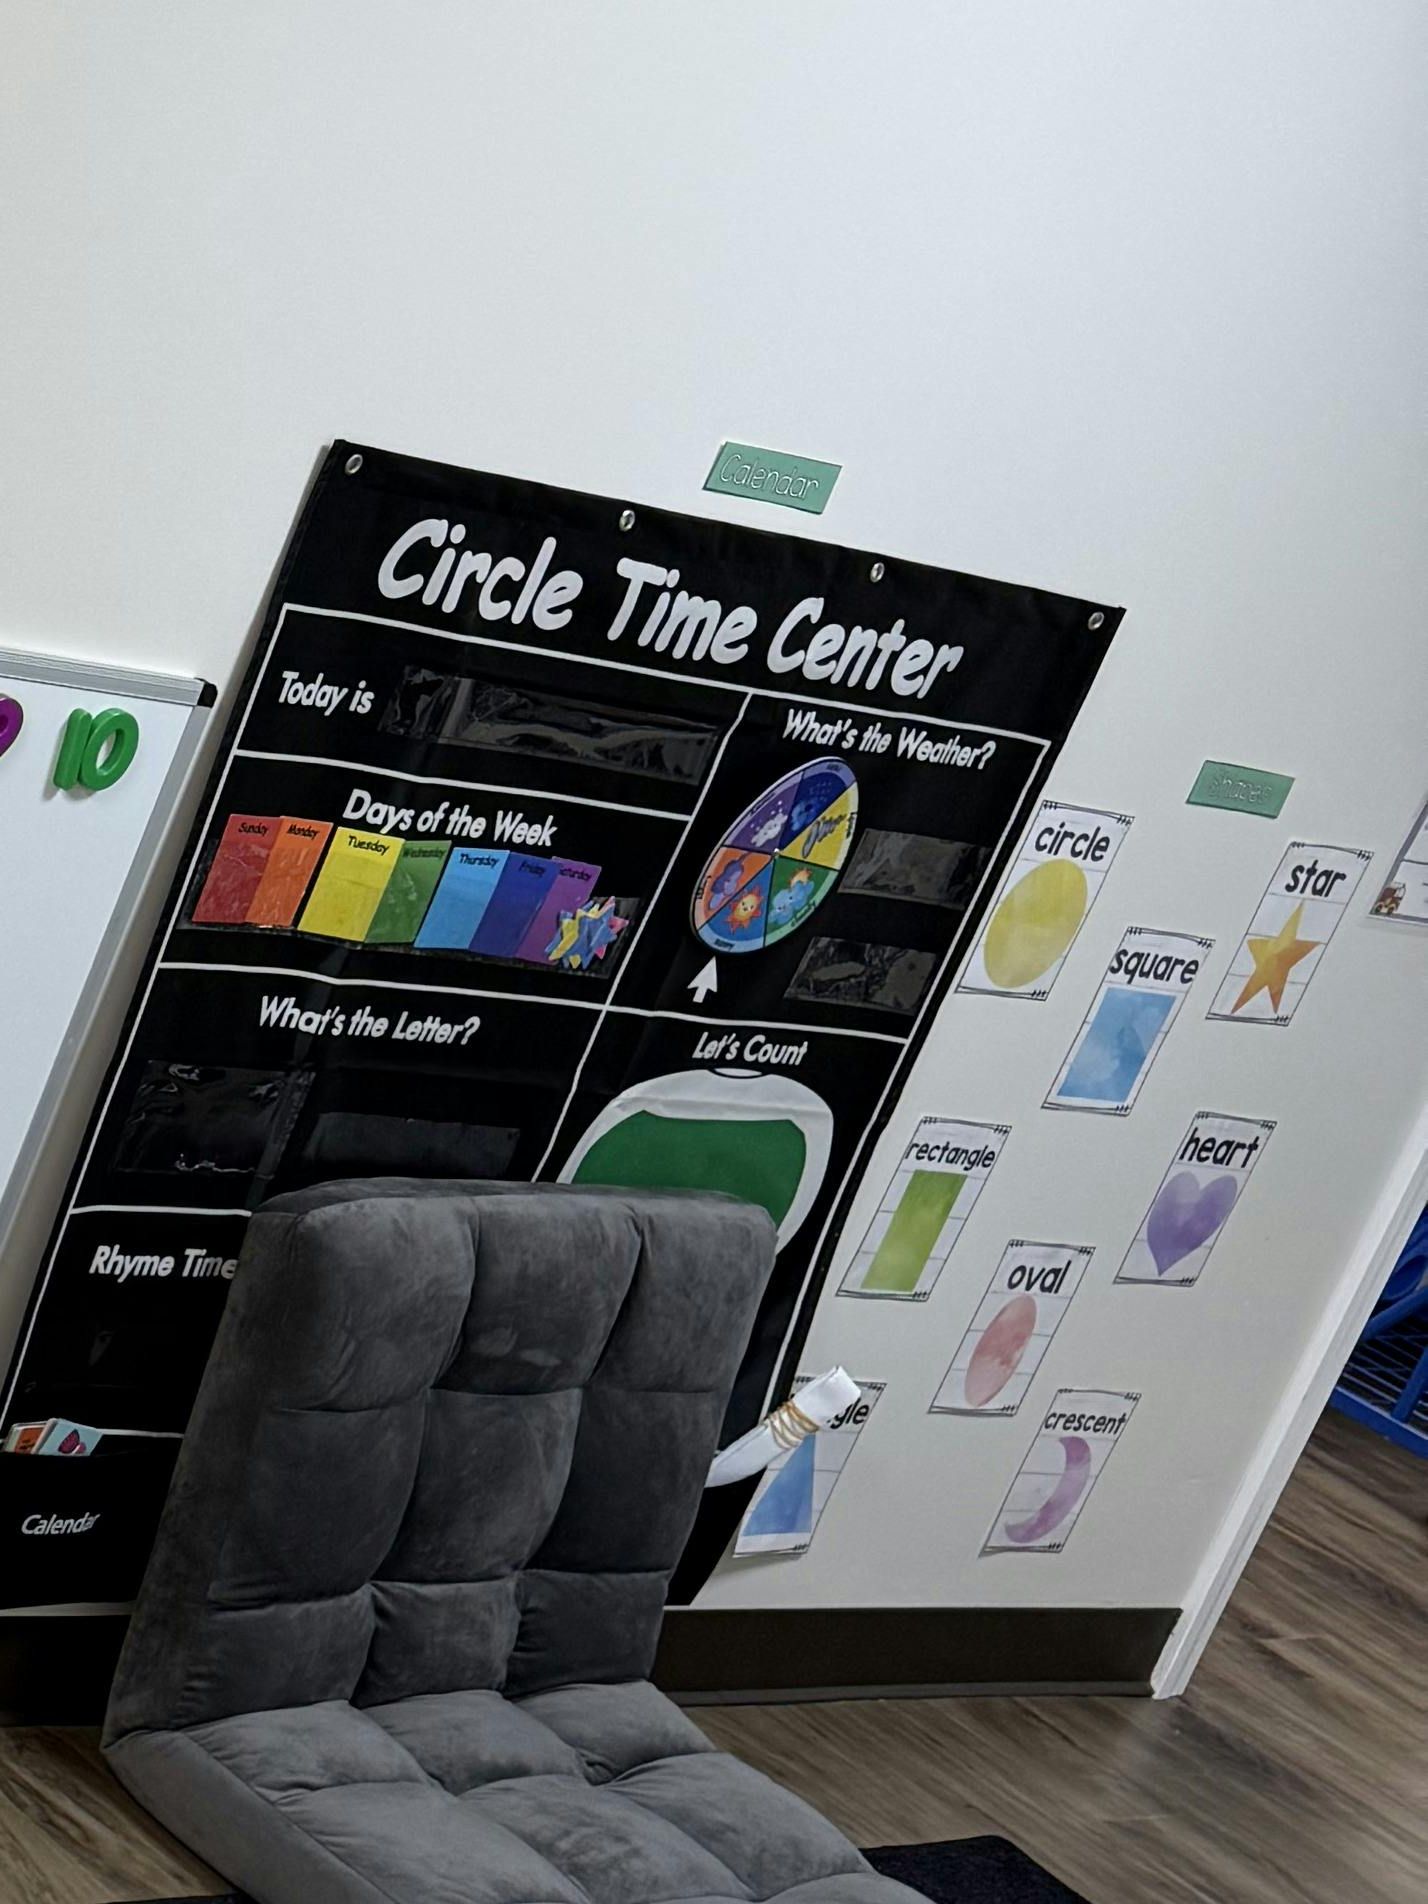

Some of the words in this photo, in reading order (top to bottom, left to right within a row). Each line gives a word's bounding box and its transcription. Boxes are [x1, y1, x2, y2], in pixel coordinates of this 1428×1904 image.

[719, 454, 820, 500] Calendar
[377, 518, 583, 631] Circle
[606, 557, 757, 663] Time
[766, 597, 964, 701] Center
[278, 671, 350, 715] Today
[350, 680, 376, 714] is
[52, 708, 139, 791] 10
[782, 709, 857, 749] What's
[858, 723, 892, 754] the
[896, 727, 996, 770] Weather?
[238, 822, 269, 836] Sunday
[286, 824, 319, 840] Monday
[343, 789, 415, 835] Days
[417, 802, 448, 833] of
[446, 804, 486, 839] the
[493, 810, 558, 847] Week
[347, 836, 390, 856] Tuesday
[459, 853, 499, 869] Thursday
[1033, 822, 1112, 863] circle
[559, 863, 592, 882] aturday
[1285, 859, 1347, 899] star
[1109, 945, 1200, 986] square
[259, 996, 344, 1035] What's
[347, 1007, 388, 1039] the
[393, 1010, 481, 1047] Letter?
[693, 1031, 741, 1063] Let's
[744, 1034, 808, 1067] Count
[905, 1136, 996, 1173] rectangle
[1178, 1127, 1260, 1167] heart
[89, 1244, 175, 1283] Rhyme
[181, 1248, 240, 1280] Time
[1007, 1261, 1072, 1295] oval
[1043, 1408, 1127, 1437] crescent
[21, 1512, 101, 1536] Calendar
